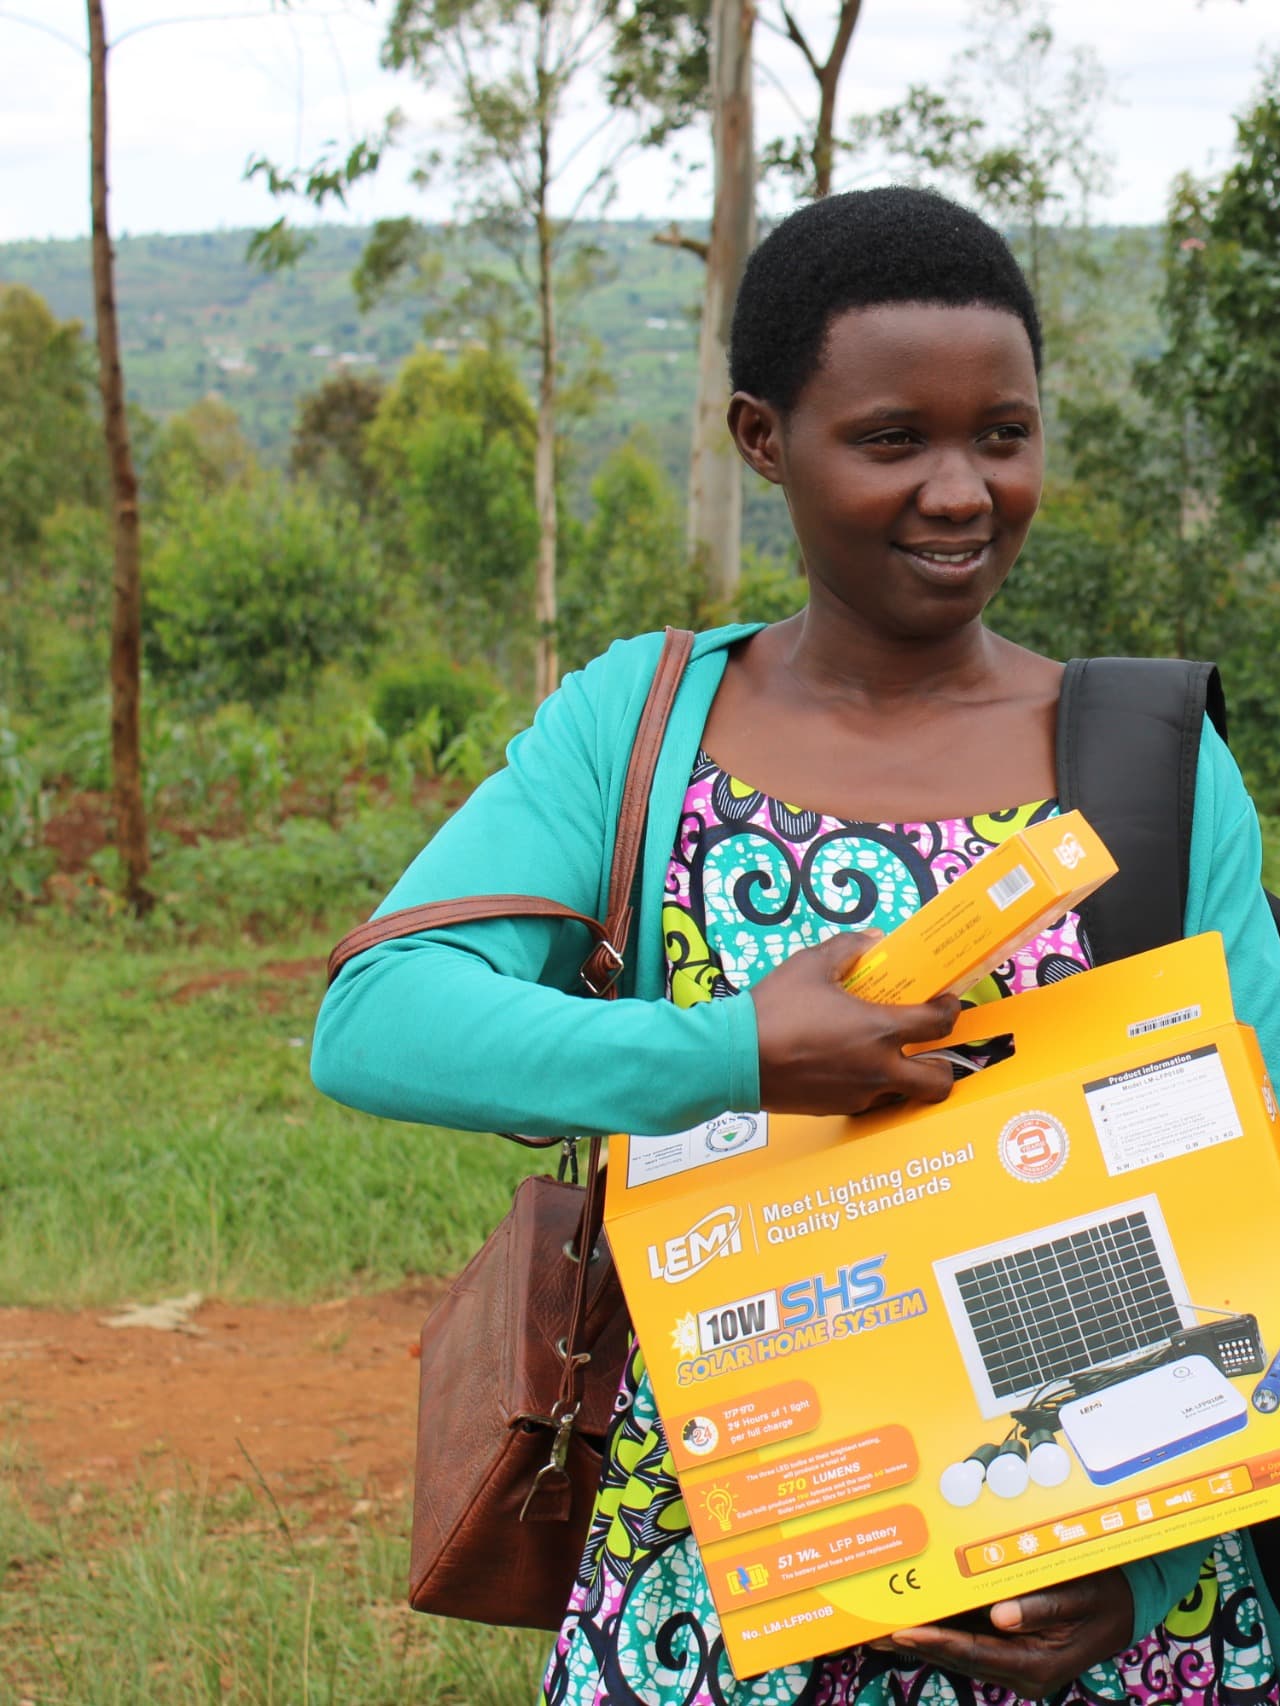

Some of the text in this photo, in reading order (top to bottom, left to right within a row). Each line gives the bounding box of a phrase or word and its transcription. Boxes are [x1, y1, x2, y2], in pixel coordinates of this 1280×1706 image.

[1108, 1054, 1191, 1084] Product information
[762, 1144, 974, 1224] Meet Lighting Global
[767, 1176, 951, 1245] Quality Standards
[648, 1206, 742, 1284] LEMI
[706, 1254, 887, 1346] 10W SHS
[677, 1289, 927, 1386] SOLAR HOME SYSTEM
[730, 1418, 793, 1444] per full charge
[742, 1412, 768, 1425] Hours
[769, 1407, 780, 1417] of
[789, 1398, 810, 1412] light
[692, 1426, 713, 1443] 24
[776, 1461, 862, 1495] 570 LUMENS
[776, 1554, 794, 1568] 51
[828, 1538, 853, 1552] LFP
[855, 1524, 898, 1545] Battery
[742, 1606, 834, 1641] No. LM-LFP010B
